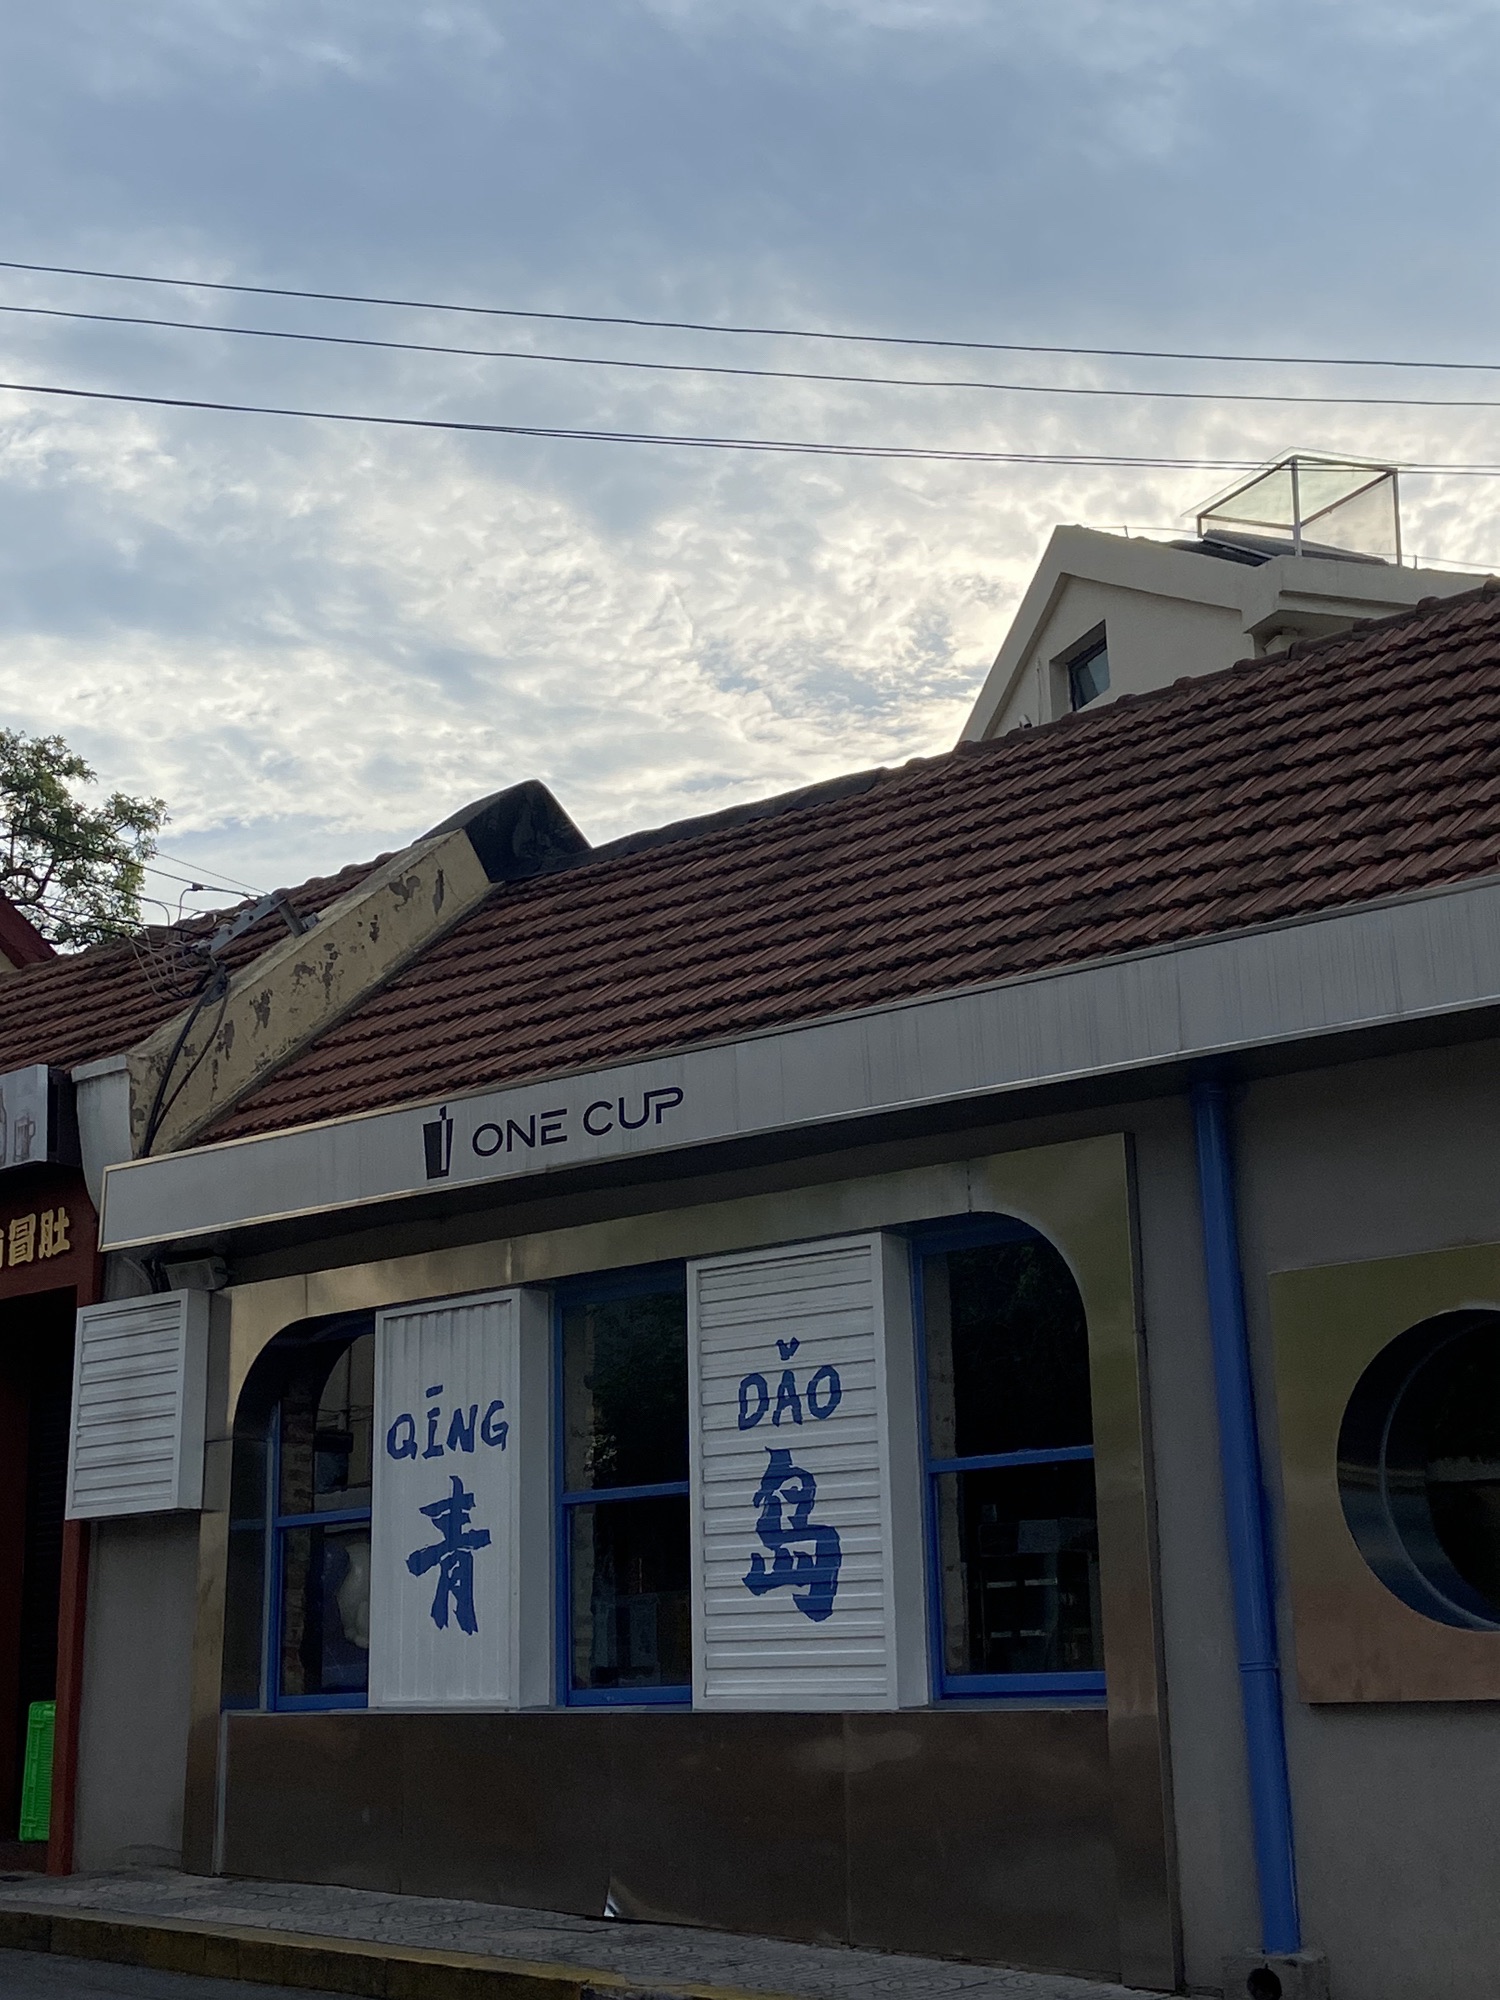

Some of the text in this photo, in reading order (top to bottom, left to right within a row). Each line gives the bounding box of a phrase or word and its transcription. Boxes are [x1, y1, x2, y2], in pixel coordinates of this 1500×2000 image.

[472, 1086, 684, 1157] ONE CUP
[0, 1206, 71, 1268] 冒肚
[405, 1475, 492, 1636] 青
